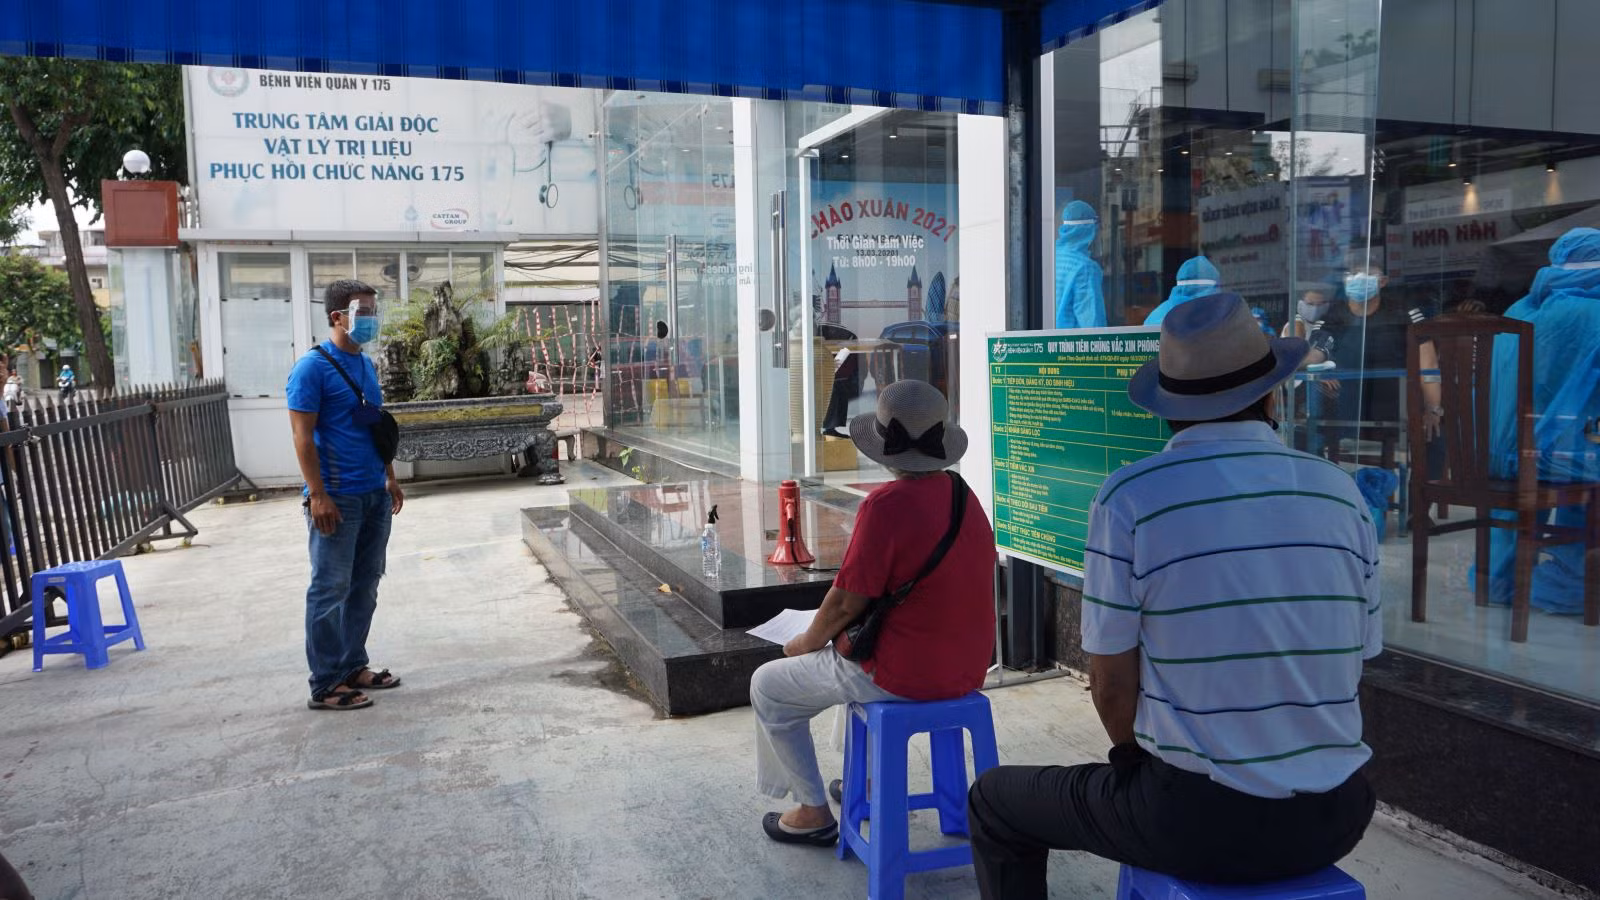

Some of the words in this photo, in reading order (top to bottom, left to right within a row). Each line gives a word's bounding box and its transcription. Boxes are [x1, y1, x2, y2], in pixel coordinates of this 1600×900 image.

[259, 73, 291, 90] BỆNH
[295, 74, 322, 91] VIỆN
[326, 75, 357, 91] QUÂN
[361, 78, 368, 91] Y
[372, 79, 391, 91] 175
[232, 112, 300, 129] TRUNG
[305, 111, 349, 131] TÂM
[354, 111, 394, 132] GIẢI
[400, 114, 439, 136] ĐỘC
[264, 137, 302, 157] VẬT
[308, 137, 332, 156] LÝ
[334, 140, 366, 161] TRỊ
[372, 139, 412, 160] LIỆU
[210, 162, 265, 183] PHỤC
[271, 159, 306, 181] HỒI
[313, 158, 365, 181] CHỨC
[371, 163, 424, 182] NĂNG
[431, 166, 464, 183] 175
[856, 198, 910, 221] XUÂN
[911, 207, 958, 242] 2021
[827, 235, 849, 251] Thời
[852, 236, 875, 250] Gian
[878, 235, 899, 249] Làm
[901, 235, 924, 252] Việc
[852, 256, 877, 267] 8h00
[886, 255, 916, 267] 19h00
[1047, 341, 1058, 354] QUY
[1059, 339, 1074, 352] TRÌNH
[1124, 340, 1136, 352] XIN
